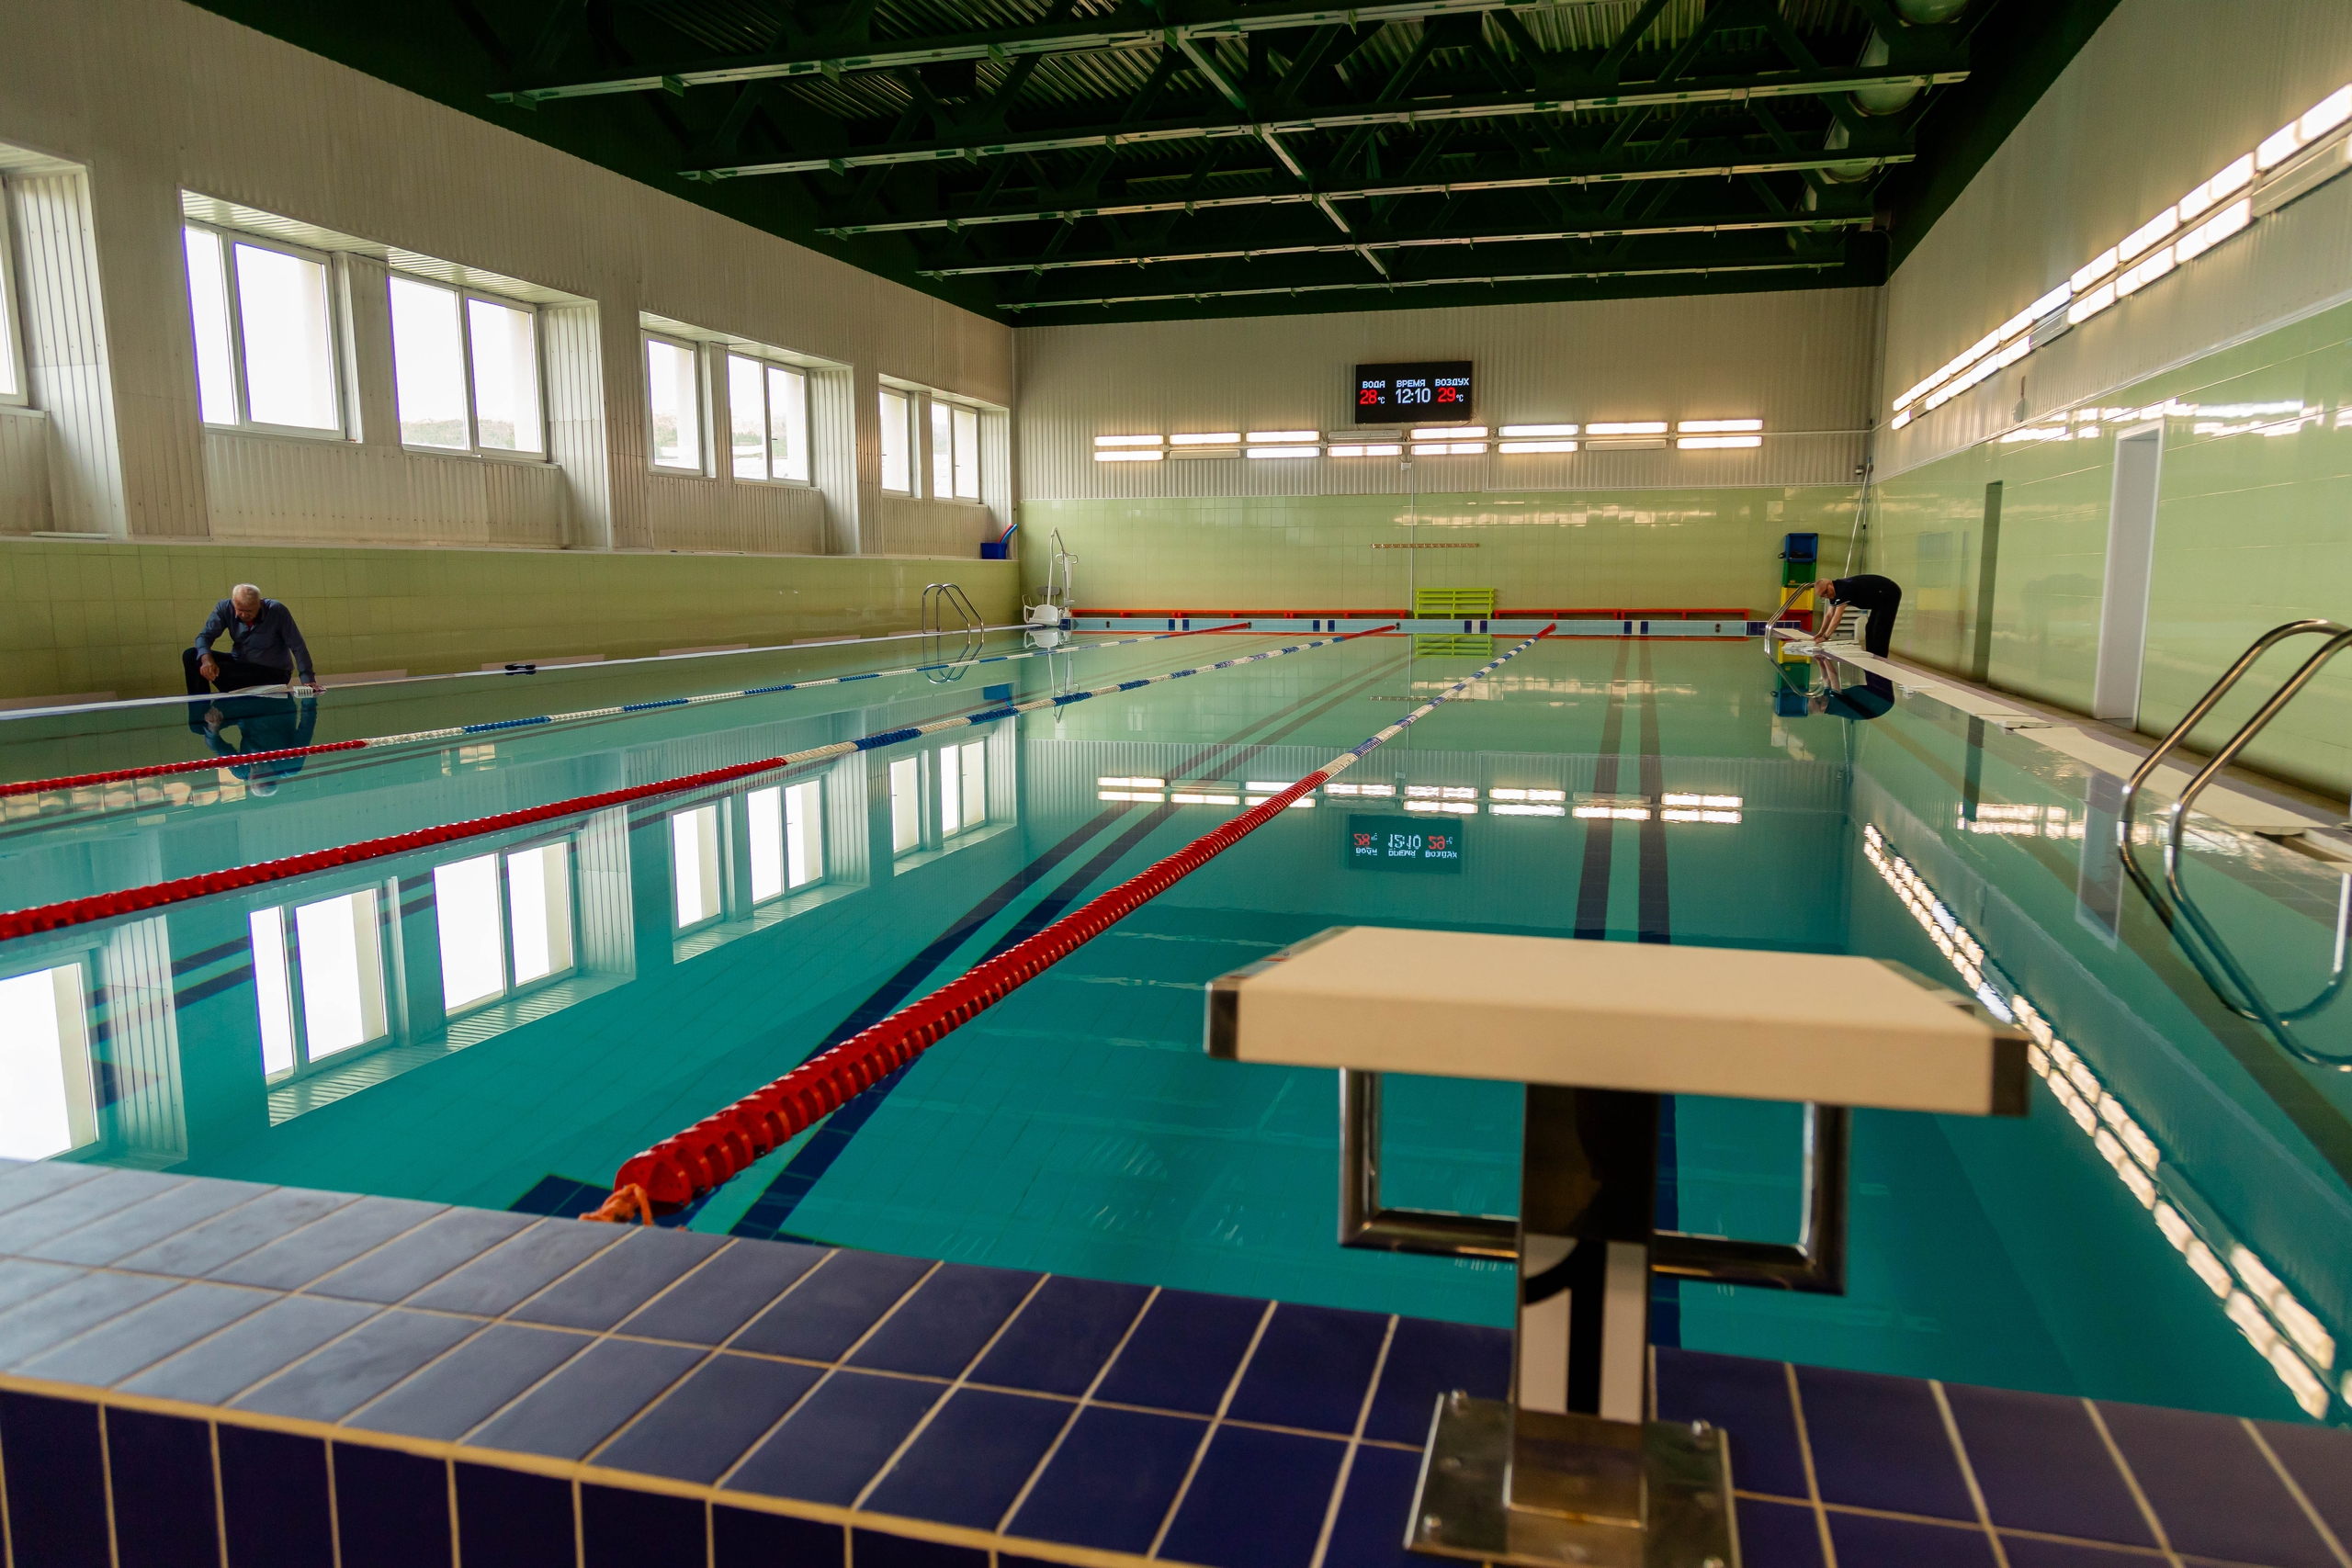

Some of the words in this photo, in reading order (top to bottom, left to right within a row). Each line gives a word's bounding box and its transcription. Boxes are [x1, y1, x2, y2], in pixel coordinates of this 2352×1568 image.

[1363, 380, 1385, 389] ВОДА
[1396, 379, 1426, 388] ВРЕМЯ
[1435, 378, 1469, 387] ВОЗДУХ
[1360, 389, 1377, 404] 28
[1396, 388, 1430, 404] 12:10
[1438, 387, 1456, 402] 29
